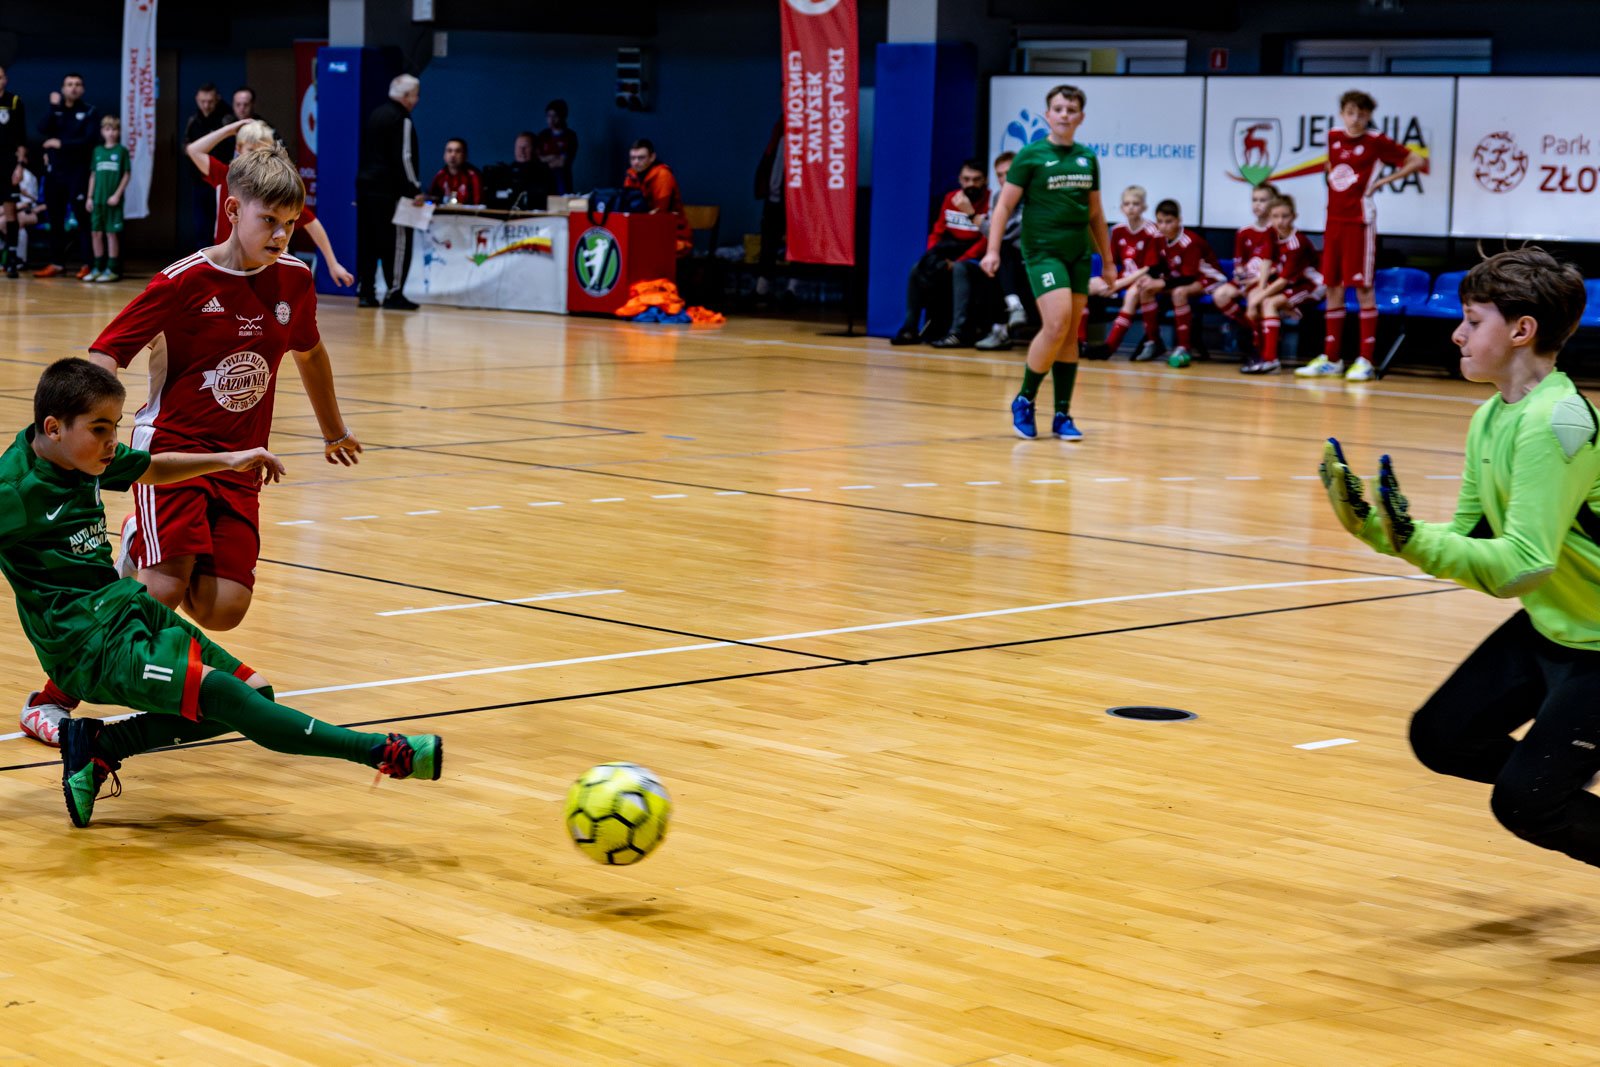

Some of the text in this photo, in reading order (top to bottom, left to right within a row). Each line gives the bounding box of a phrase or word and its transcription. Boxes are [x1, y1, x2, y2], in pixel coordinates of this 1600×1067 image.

[1114, 143, 1197, 159] CIEPLICKIE
[1542, 133, 1591, 155] Park
[1539, 164, 1600, 193] ZŁO
[1041, 271, 1056, 288] 21
[226, 353, 264, 369] PIZZERIA
[218, 372, 266, 391] GAZOWNIA
[143, 664, 173, 682] 11
